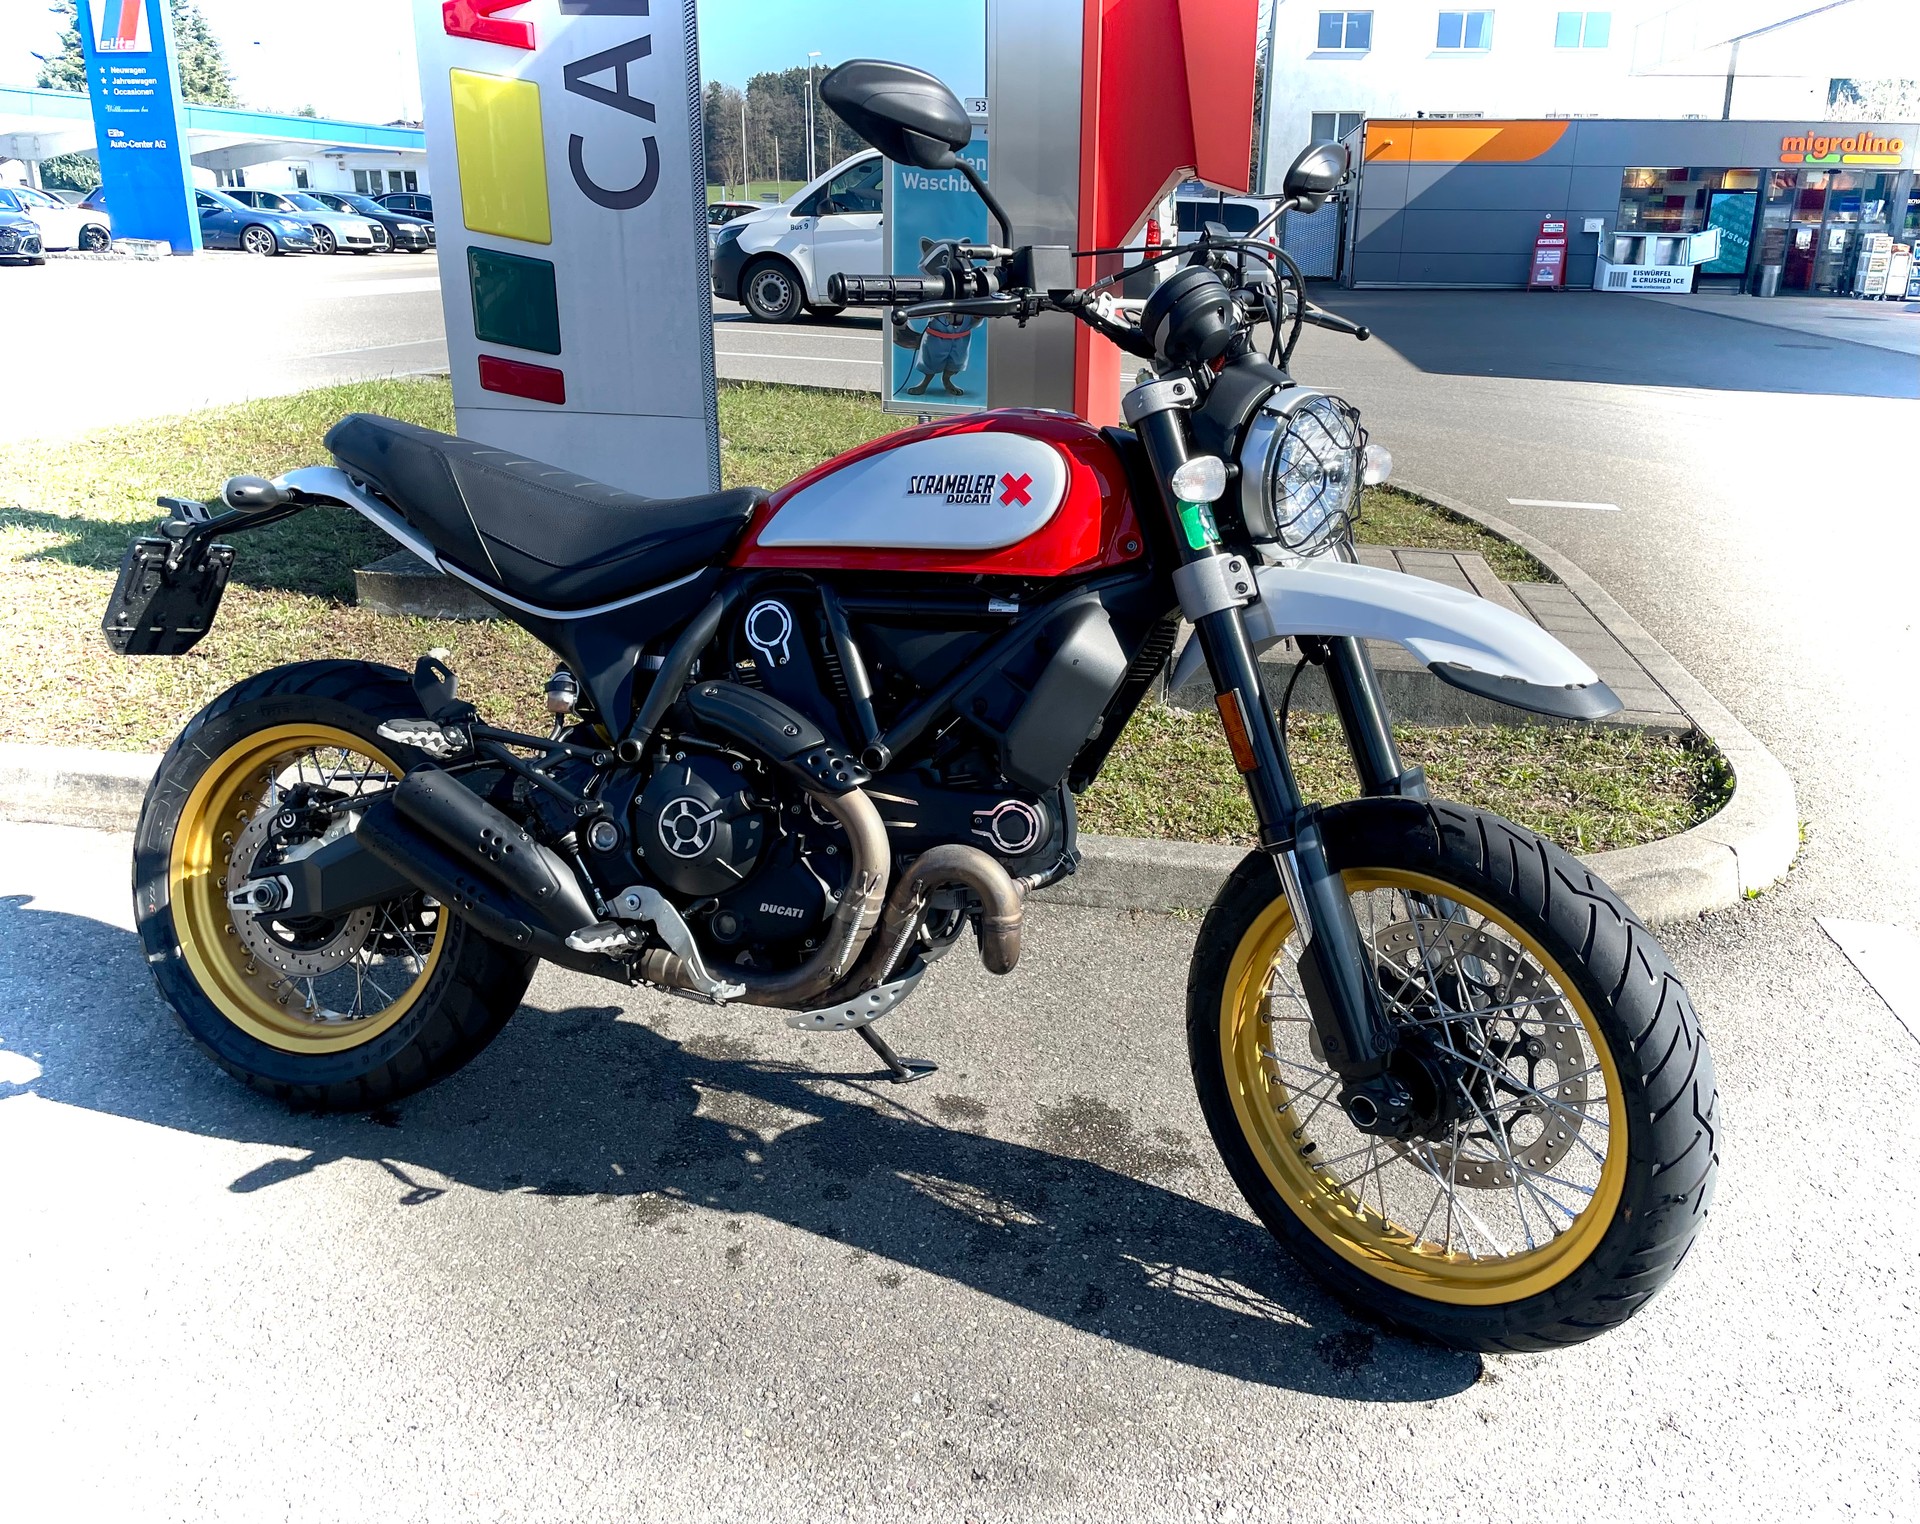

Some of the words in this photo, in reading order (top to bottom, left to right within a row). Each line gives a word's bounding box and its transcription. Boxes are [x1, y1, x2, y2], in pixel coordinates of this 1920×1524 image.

[100, 37, 136, 50] elite
[110, 66, 147, 75] Neuwagen
[112, 77, 158, 86] Jahreswagen
[113, 88, 154, 96] Occasionen
[975, 101, 987, 112] 53
[107, 128, 125, 137] Elite
[110, 139, 154, 149] Auto-Center
[154, 140, 167, 149] AG
[1781, 130, 1905, 159] migrolino
[803, 222, 809, 230] 9
[1633, 269, 1672, 277] EISWÜRFEL
[906, 474, 997, 495] SCRAMBLER
[946, 494, 992, 504] DUCATI
[759, 902, 805, 919] DUCATI
